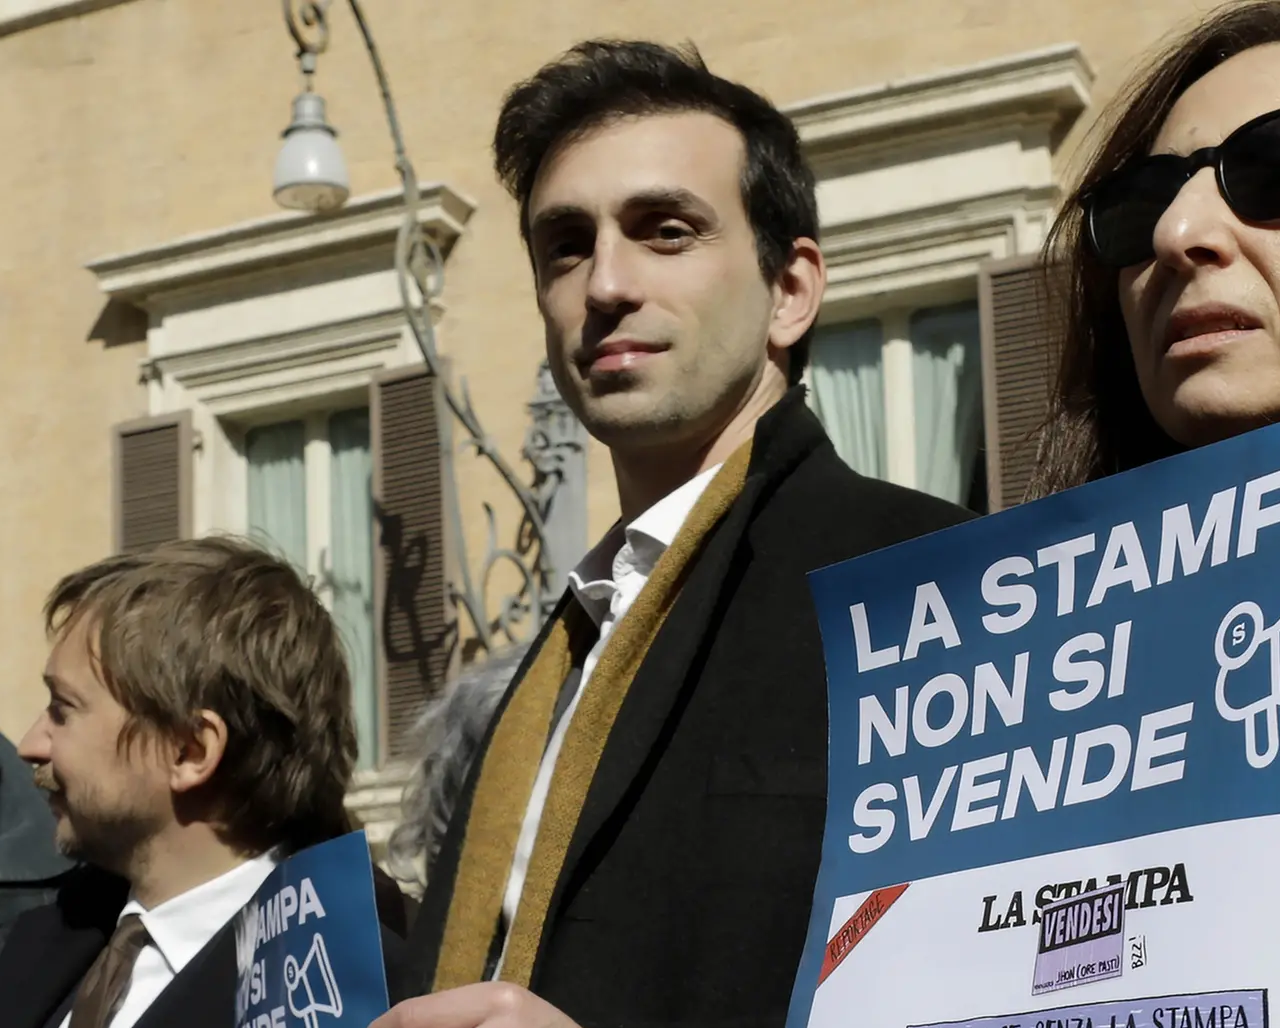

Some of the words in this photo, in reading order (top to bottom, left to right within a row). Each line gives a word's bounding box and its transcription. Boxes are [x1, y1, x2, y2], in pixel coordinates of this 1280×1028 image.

[849, 581, 962, 674] LA
[857, 651, 1030, 765] NON
[1048, 619, 1132, 711] SI
[848, 701, 1195, 854] SVENDE
[253, 877, 326, 949] AMPA
[829, 892, 885, 962] REPORTAGE
[978, 891, 1026, 933] LA
[1043, 892, 1120, 947] VENDESI
[250, 959, 267, 1005] SI
